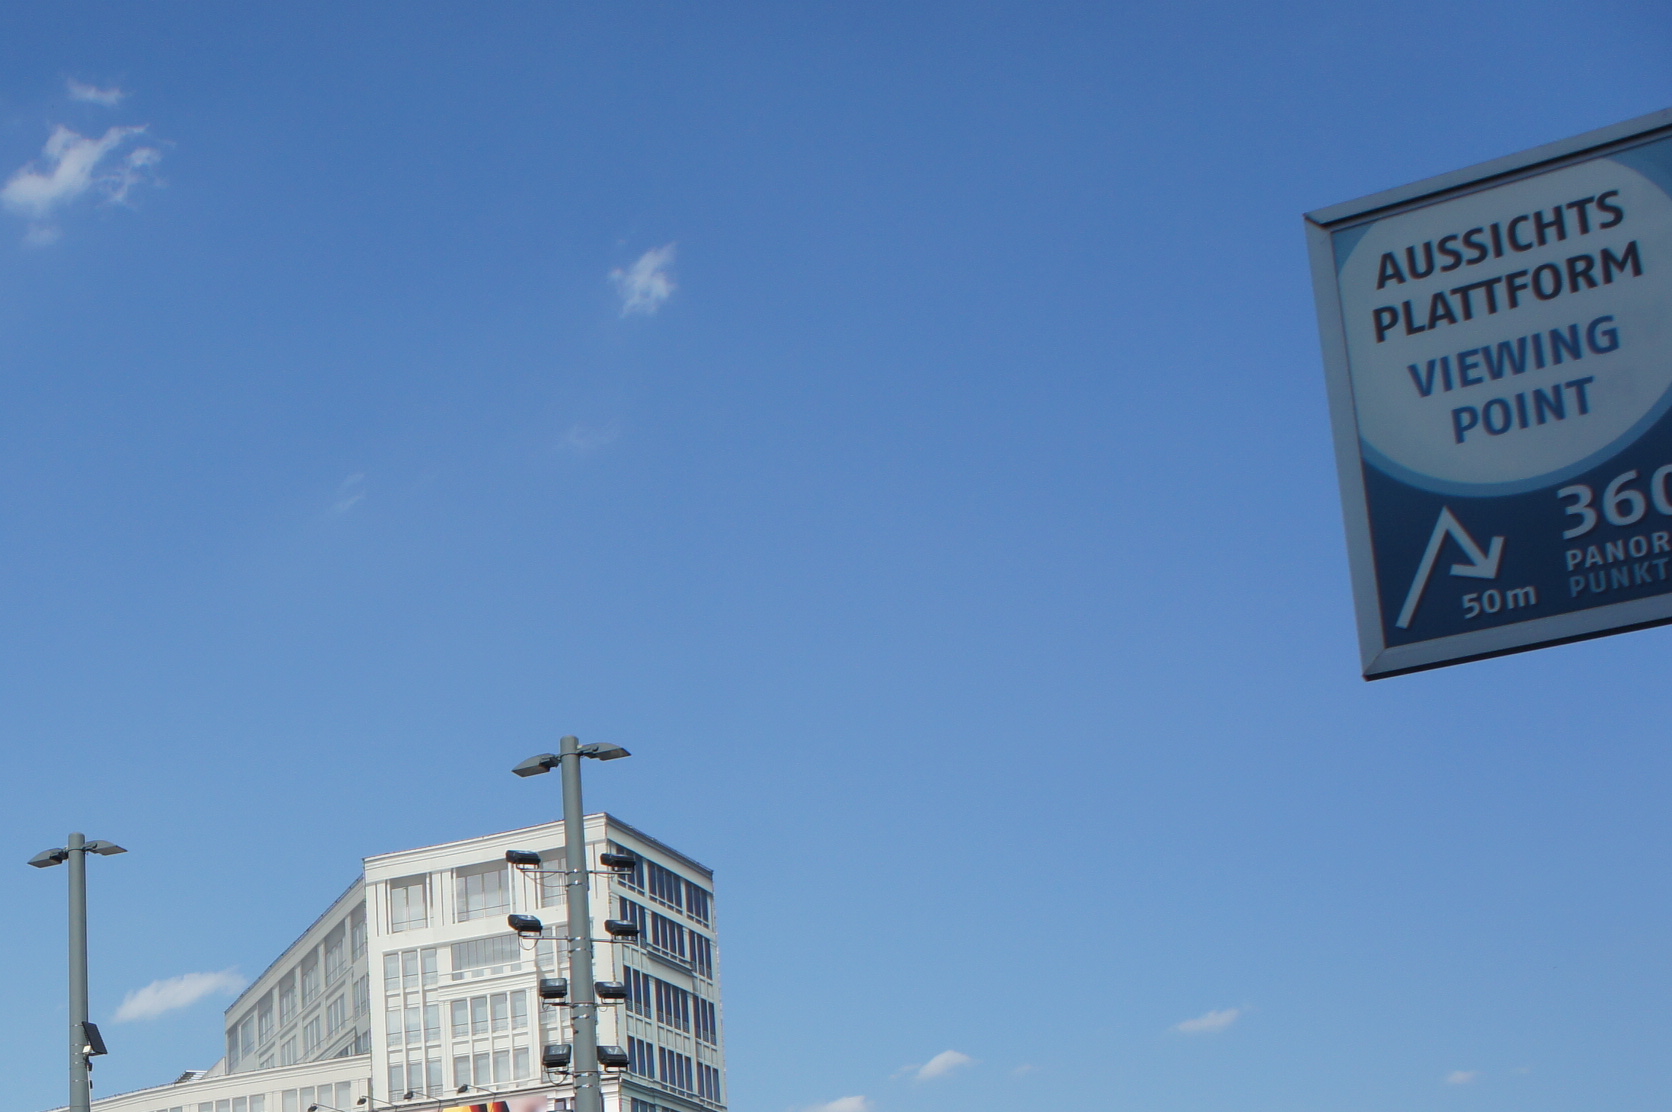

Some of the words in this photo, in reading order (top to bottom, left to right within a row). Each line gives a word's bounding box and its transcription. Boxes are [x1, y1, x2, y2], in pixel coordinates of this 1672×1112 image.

[1376, 190, 1624, 290] AUSSICHTS
[1372, 240, 1643, 343] PLATTFORM
[1407, 315, 1620, 398] VIEWING
[1452, 375, 1594, 444] POINT
[1569, 557, 1669, 598] PUNKT
